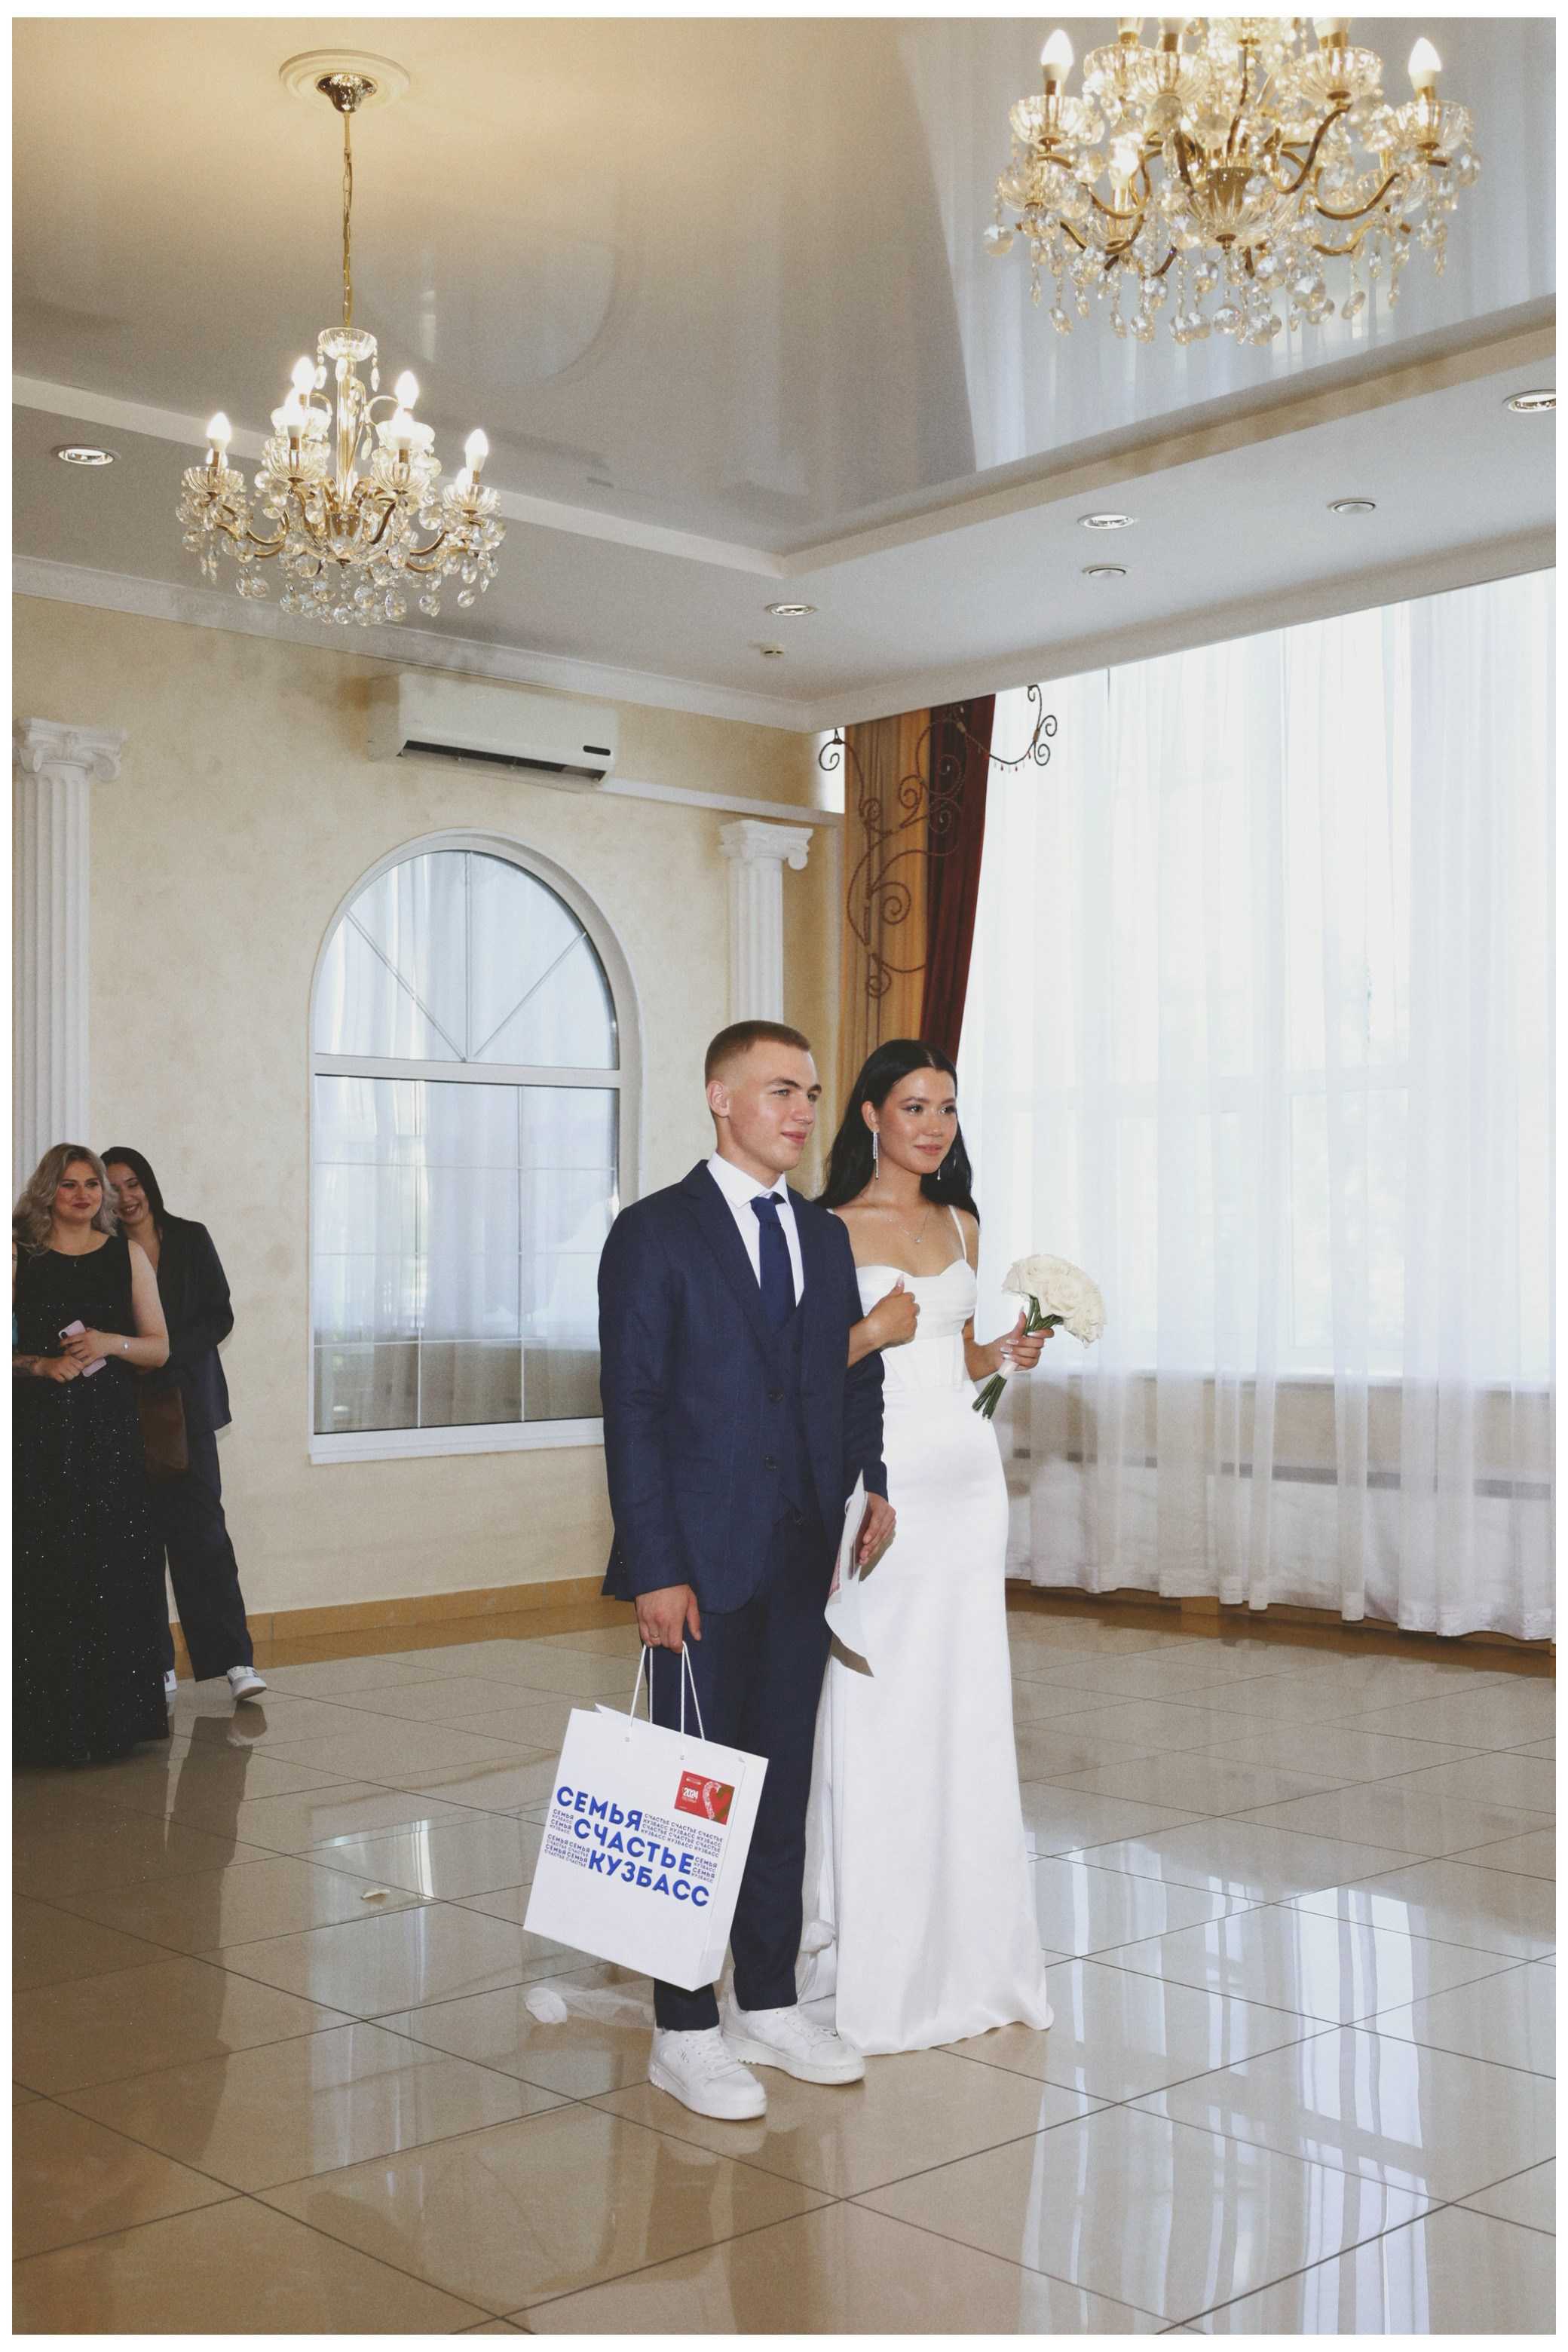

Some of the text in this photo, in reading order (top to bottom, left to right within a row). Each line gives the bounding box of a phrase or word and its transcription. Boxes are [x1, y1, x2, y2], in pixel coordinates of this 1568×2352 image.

[683, 1787, 699, 1800] 2024
[553, 1808, 574, 1821] СЕМЬЯ
[556, 1786, 643, 1832] СЕМЬЯ
[550, 1818, 572, 1831] СЕМЬЯ
[551, 1814, 573, 1824] КУЗБАСС
[645, 1813, 724, 1842] СЧАСТЬЕ СЧАСТЬЕ СЧАСТЬЕ
[549, 1824, 571, 1835] КУЗБАСС
[642, 1824, 721, 1853] СЧАСТЬЕ СЧАСТЬЕ СЧАСТЬЕ
[643, 1818, 722, 1848] КУЗБАСС КУЗБАСС КУЗБАСС
[547, 1833, 590, 1854] СЕМЬЯ СЕМЬЯ
[547, 1839, 589, 1857] СЧАСТЬЕ СЧАСТЬЕ
[574, 1818, 694, 1875] СЧАСТЬЕ
[641, 1829, 720, 1858] КУЗБАСС КУЗБАСС КУЗБАСС
[544, 1849, 586, 1868] СЧАСТЬЕ СЧАСТЬЕ
[545, 1844, 588, 1864] СЕМЬЯ СЕМЬЯ
[695, 1857, 718, 1868] СЕМЬЯ
[692, 1867, 715, 1879] СЕМЬЯ
[694, 1862, 716, 1873] КУЗБАСС
[588, 1849, 710, 1907] КУЗБАСС
[691, 1873, 714, 1884] КУЗБАСС
